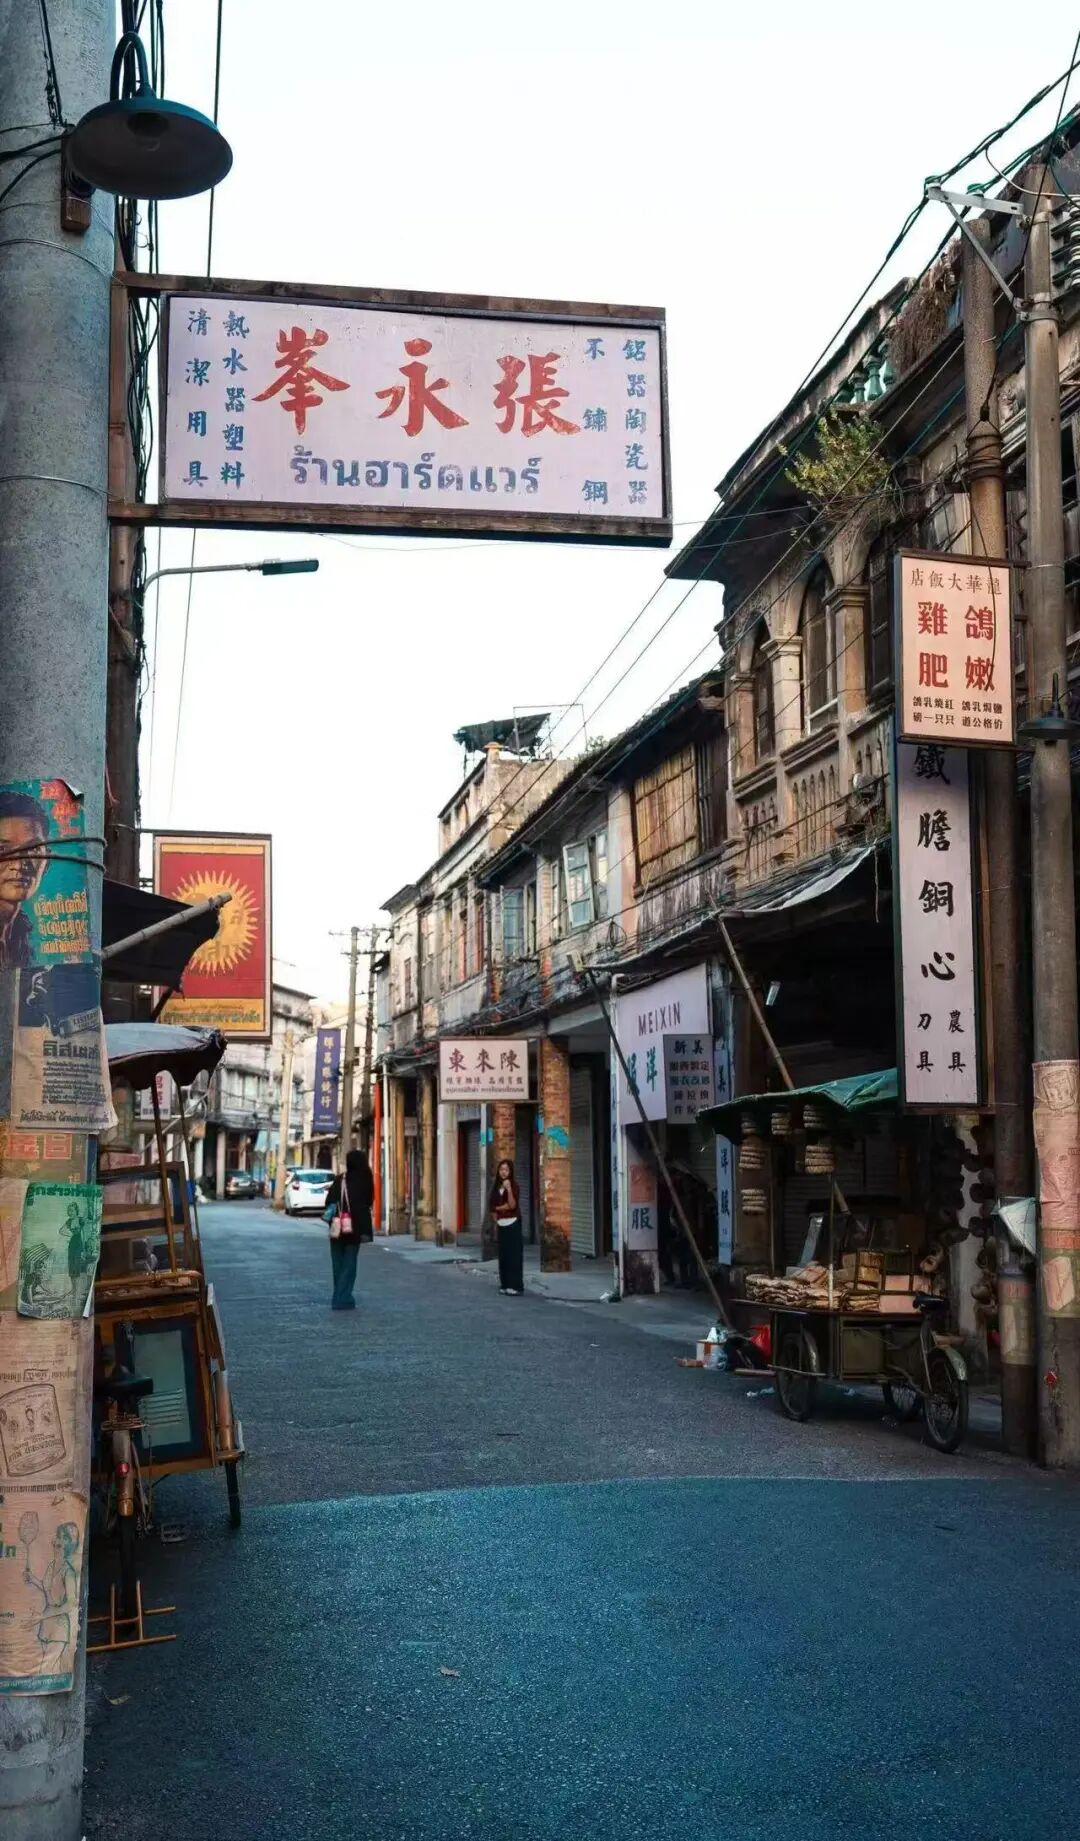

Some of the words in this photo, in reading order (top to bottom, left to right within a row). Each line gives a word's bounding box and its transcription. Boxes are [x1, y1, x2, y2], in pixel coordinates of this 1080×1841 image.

[183, 308, 212, 487] 清潔用具
[638, 1001, 681, 1036] MEIXIN
